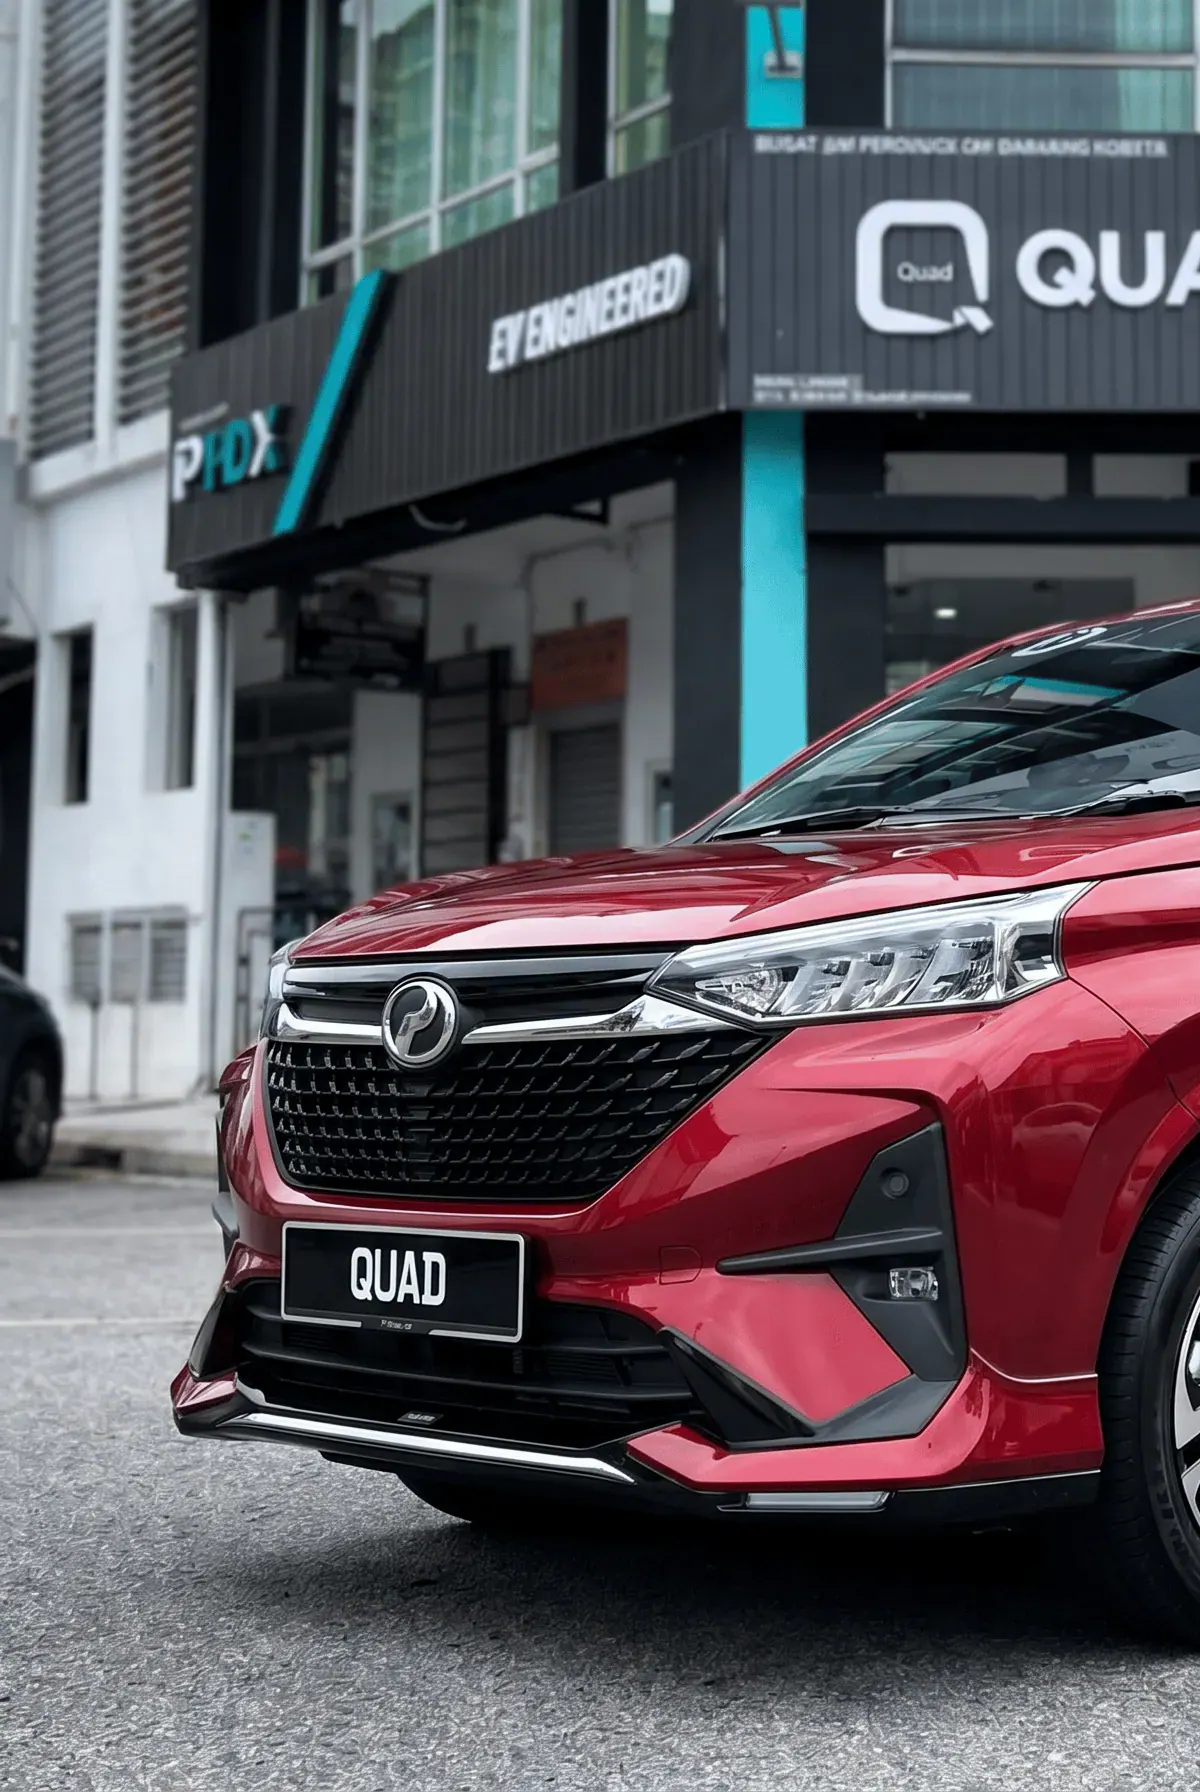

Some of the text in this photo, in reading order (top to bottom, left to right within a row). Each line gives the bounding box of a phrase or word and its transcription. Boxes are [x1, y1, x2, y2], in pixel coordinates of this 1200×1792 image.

[897, 260, 954, 283] Quad
[487, 252, 690, 374] EV ENGINEERED
[350, 1246, 447, 1306] QUAD
